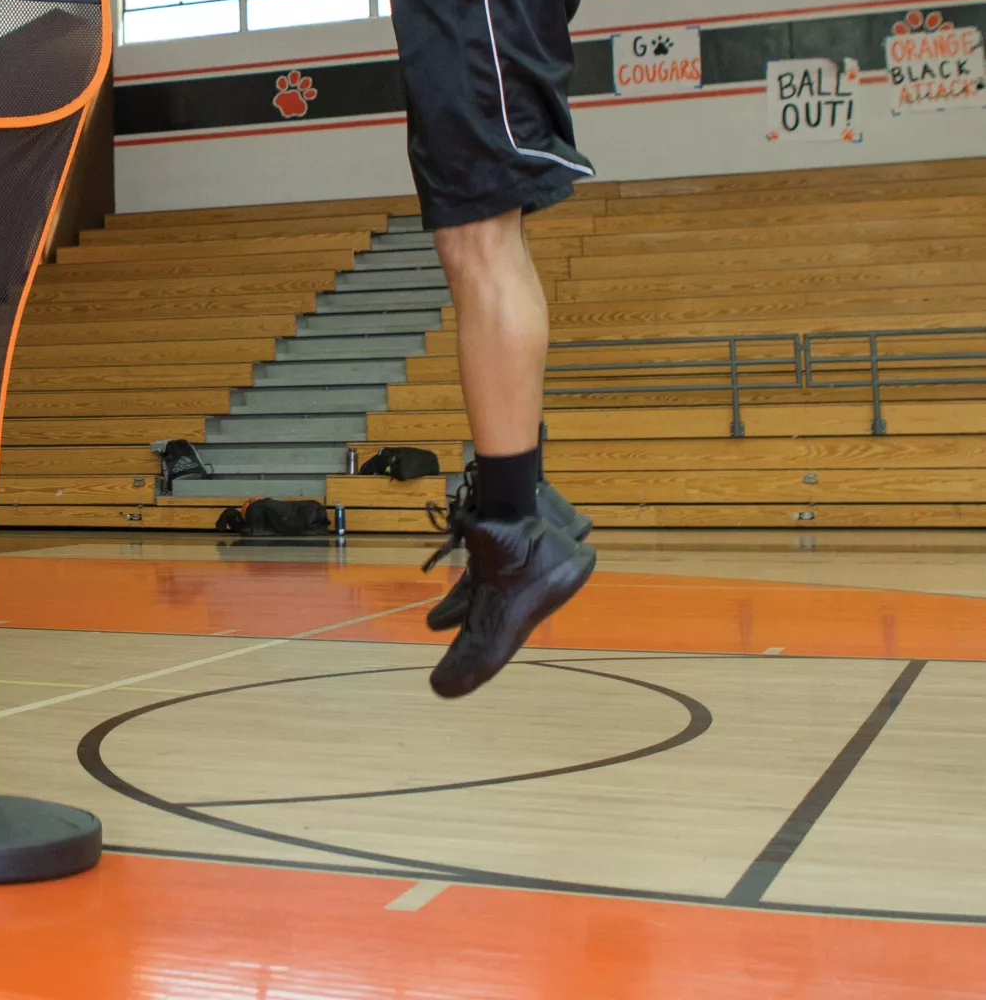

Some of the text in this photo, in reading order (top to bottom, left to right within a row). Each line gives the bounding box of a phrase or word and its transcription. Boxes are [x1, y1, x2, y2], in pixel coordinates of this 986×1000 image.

[890, 29, 975, 64] ORANGE
[618, 56, 702, 87] COUGARS
[777, 66, 853, 100] BALL
[891, 59, 970, 86] BLACK
[897, 79, 977, 108] ATTACK
[781, 99, 853, 132] OUT!
